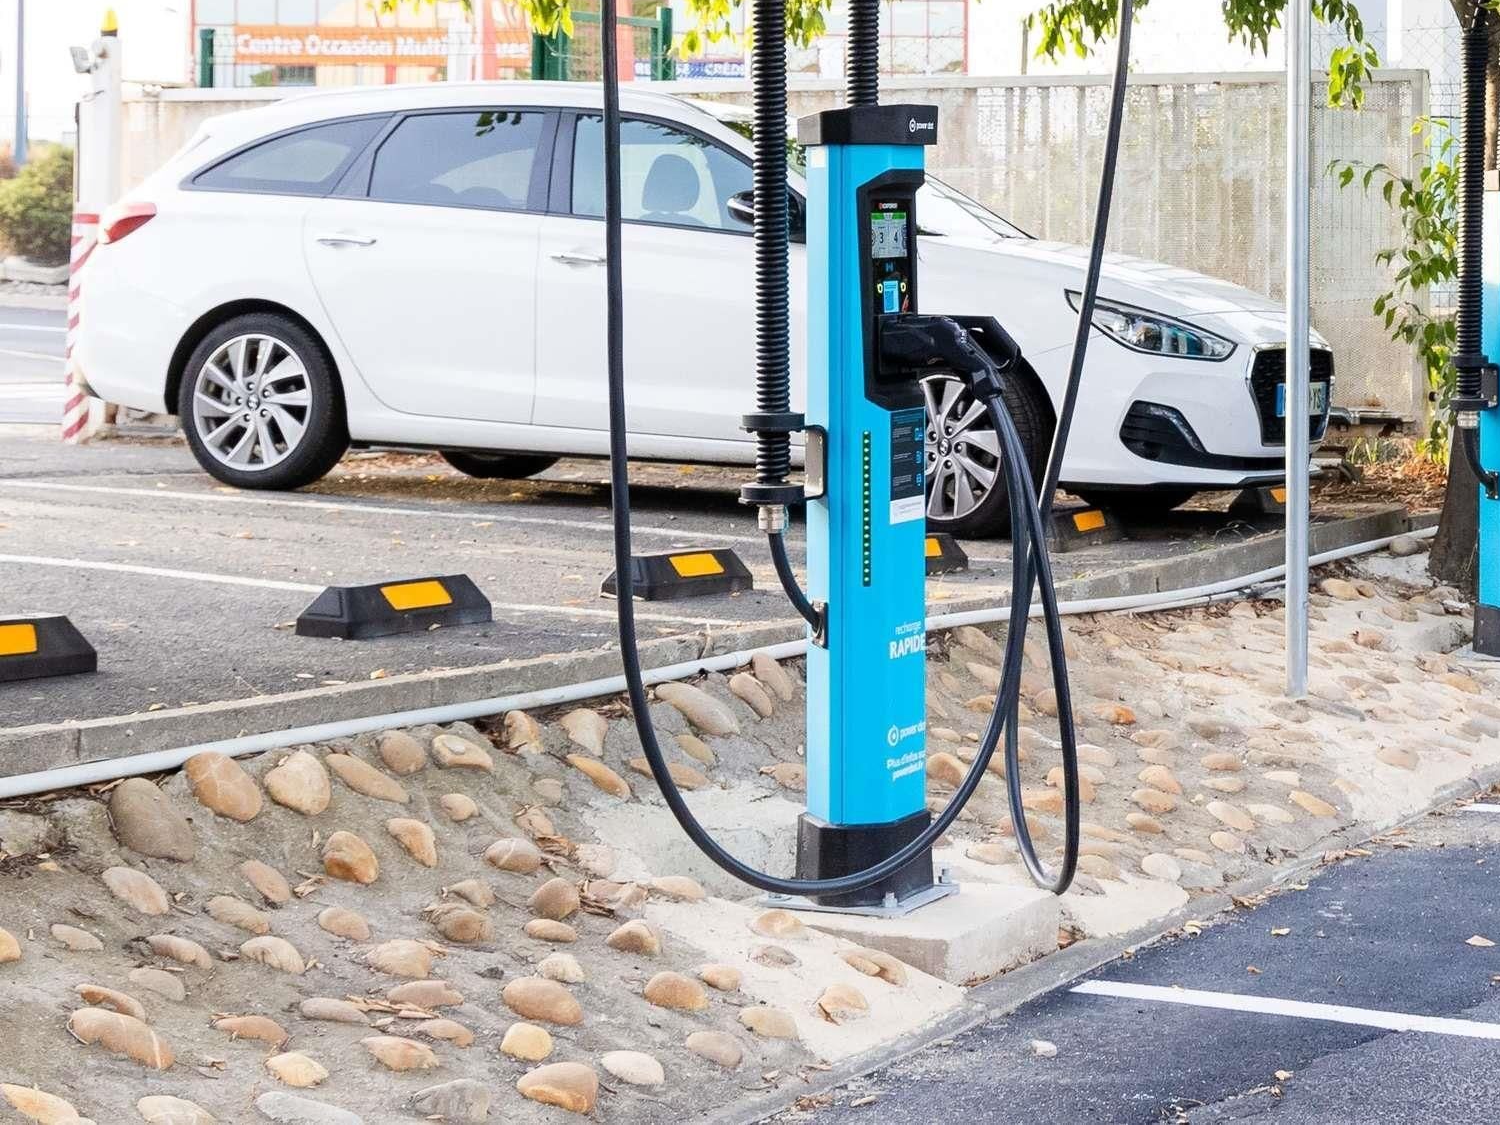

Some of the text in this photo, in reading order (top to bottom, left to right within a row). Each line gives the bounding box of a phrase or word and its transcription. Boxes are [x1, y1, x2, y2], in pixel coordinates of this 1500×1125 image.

[236, 34, 303, 55] Centre
[305, 34, 394, 55] Occasion
[879, 231, 898, 244] 3 4
[889, 632, 926, 660] RAPIDE
